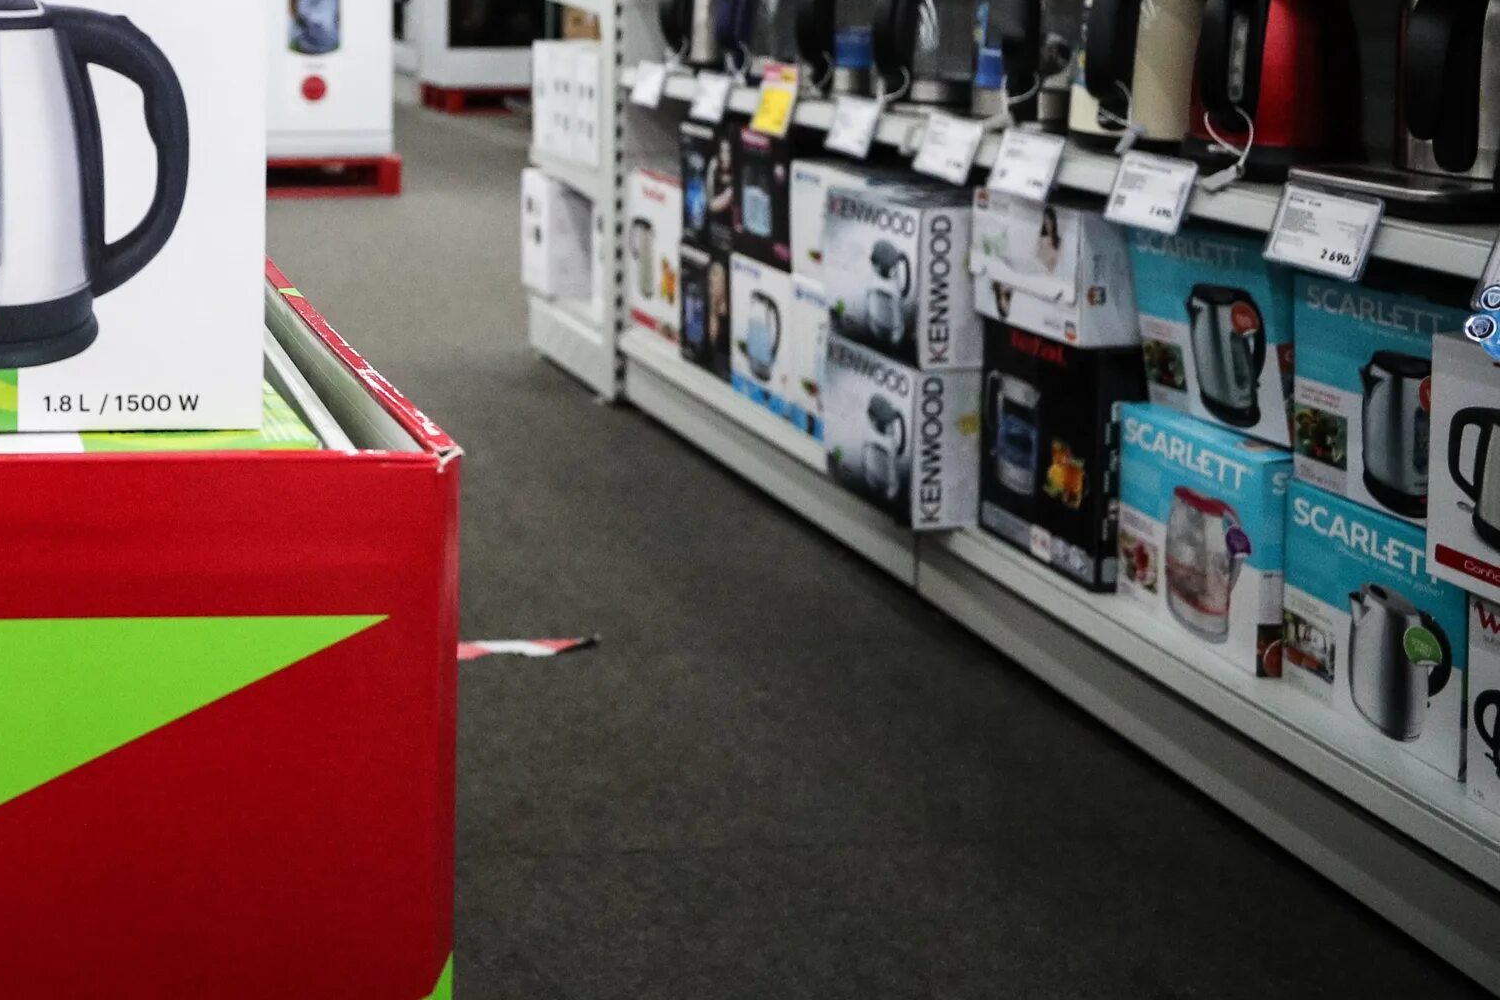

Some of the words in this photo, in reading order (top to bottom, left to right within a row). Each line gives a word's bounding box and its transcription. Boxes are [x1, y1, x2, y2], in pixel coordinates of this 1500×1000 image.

[828, 194, 916, 238] KENWOOD
[928, 213, 952, 363] KENWOOD
[43, 394, 72, 413] 1.8
[78, 394, 92, 412] L
[114, 394, 171, 412] 1500
[177, 394, 200, 412] W
[828, 337, 910, 398] KENWOOD
[919, 376, 945, 524] KENWOOD
[1123, 416, 1249, 490] SCARLETT
[1294, 497, 1438, 584] SCARLET
